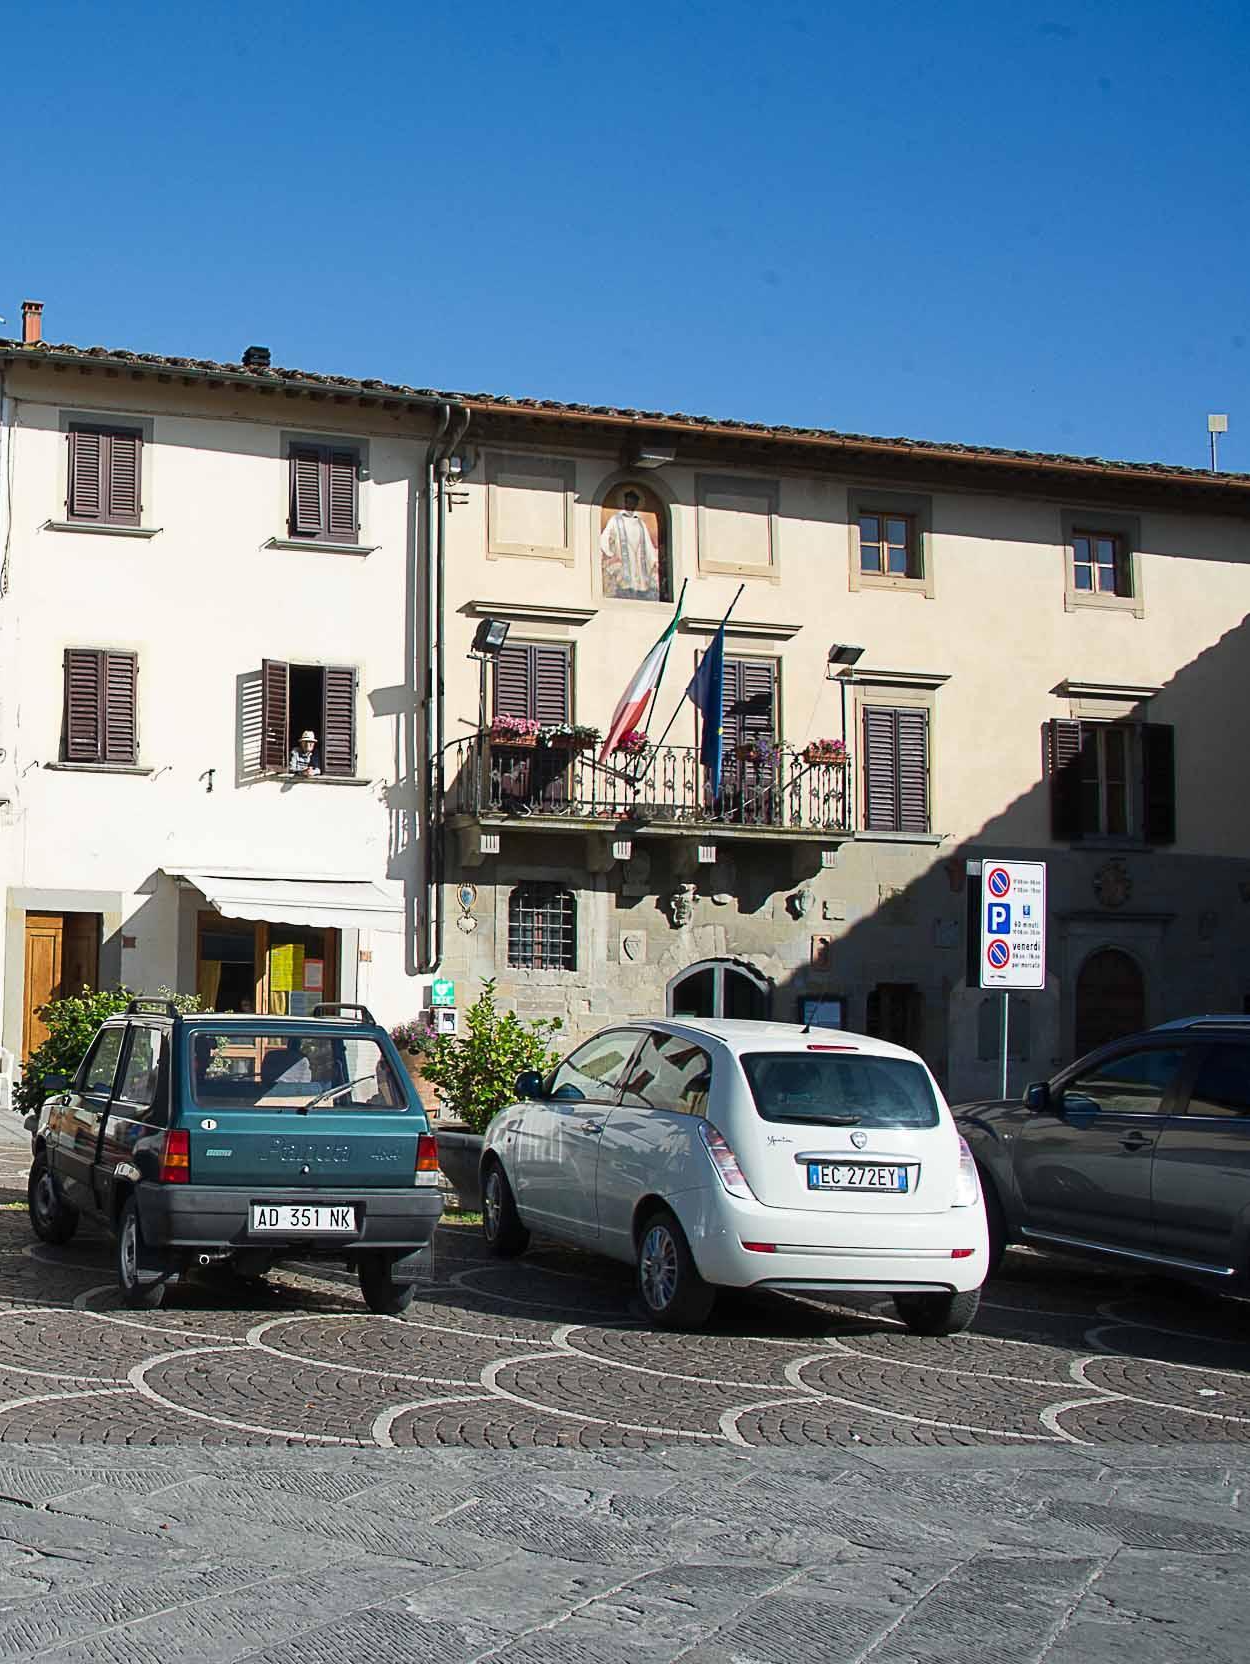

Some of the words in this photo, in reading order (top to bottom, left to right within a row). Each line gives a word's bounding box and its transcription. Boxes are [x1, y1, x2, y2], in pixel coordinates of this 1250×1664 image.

[821, 1164, 840, 1184] EC
[847, 1167, 895, 1186] 272EY
[258, 1208, 279, 1227] AD
[290, 1208, 319, 1227] 351
[330, 1208, 350, 1227] NK
